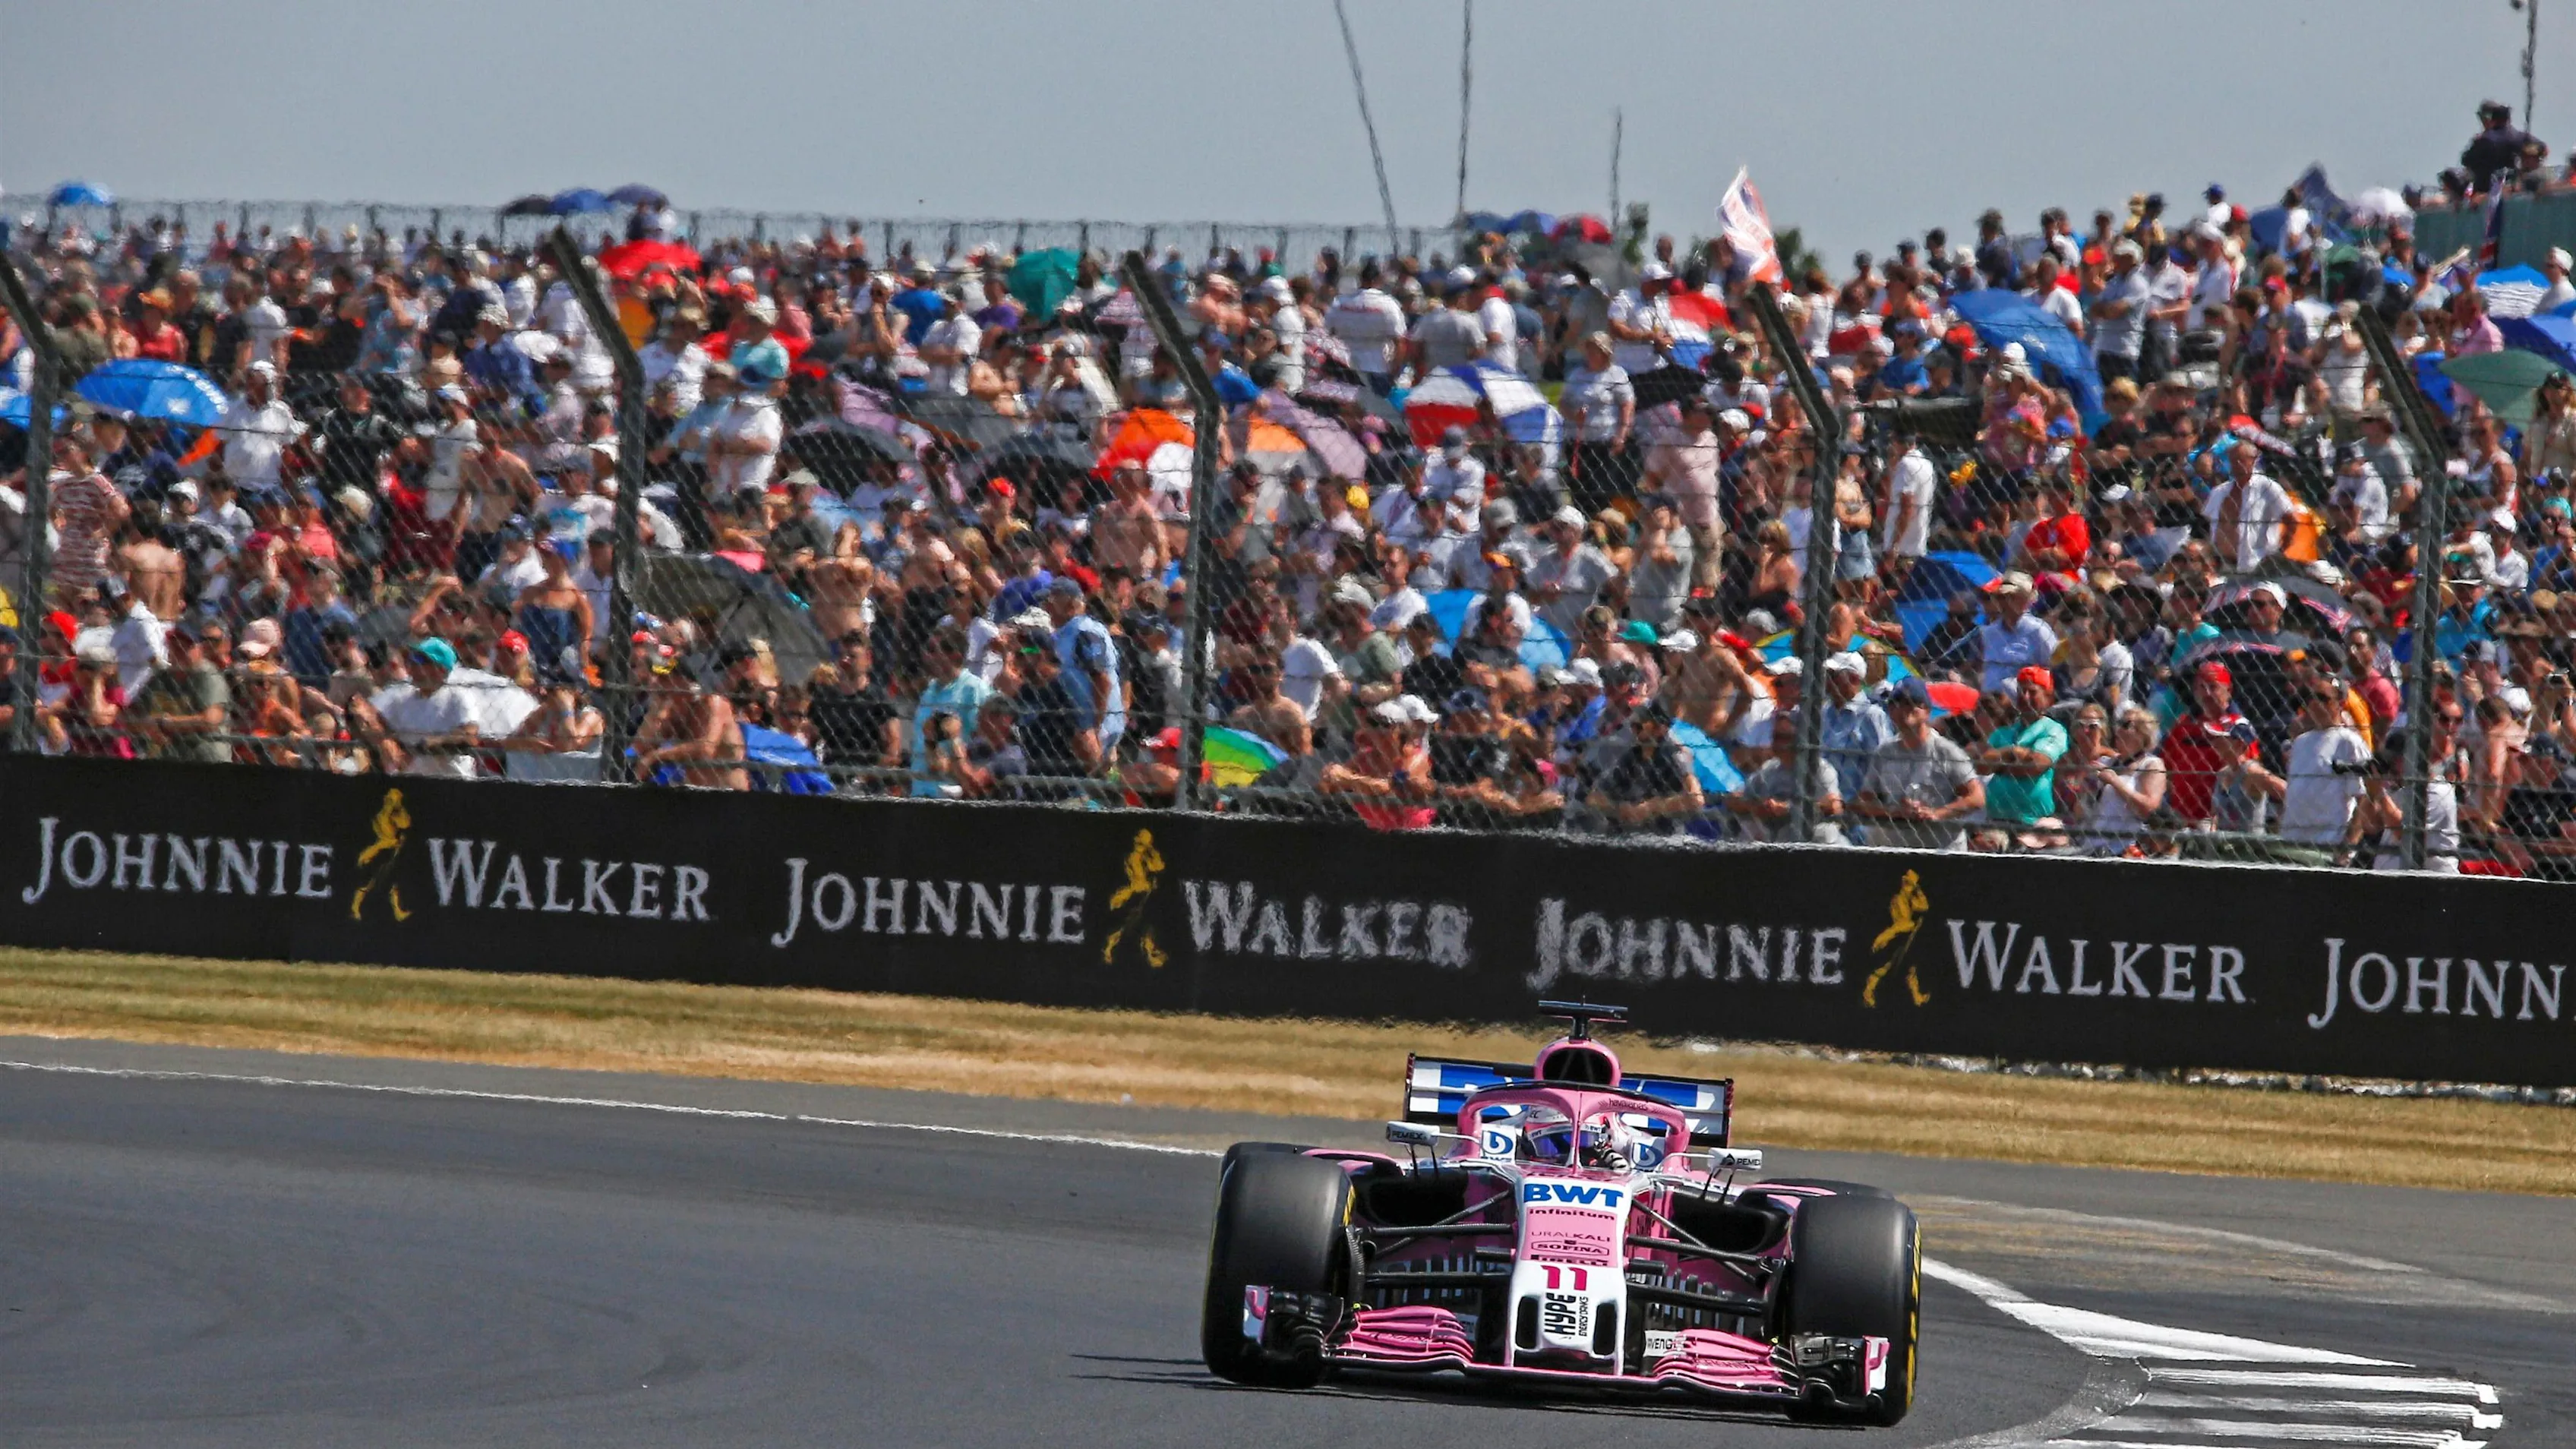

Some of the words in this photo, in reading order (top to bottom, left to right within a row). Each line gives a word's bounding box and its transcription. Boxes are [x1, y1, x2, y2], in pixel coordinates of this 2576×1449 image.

[23, 817, 334, 905] JOHNNIE
[429, 838, 710, 920] WALKER
[772, 858, 1086, 949] JOHNNIE
[1183, 881, 1473, 968] WALKER
[1527, 899, 1847, 991] JOHNNIE
[1947, 920, 2247, 1003] WALKER
[2308, 939, 2576, 1029] JOHNN
[1524, 1183, 1624, 1208] BWT
[1530, 1208, 1615, 1220] infinitum
[1531, 1231, 1610, 1242] URALKALI
[1537, 1243, 1602, 1253] SOFINA
[1540, 1265, 1587, 1291] 11
[1544, 1293, 1576, 1335] HYPE
